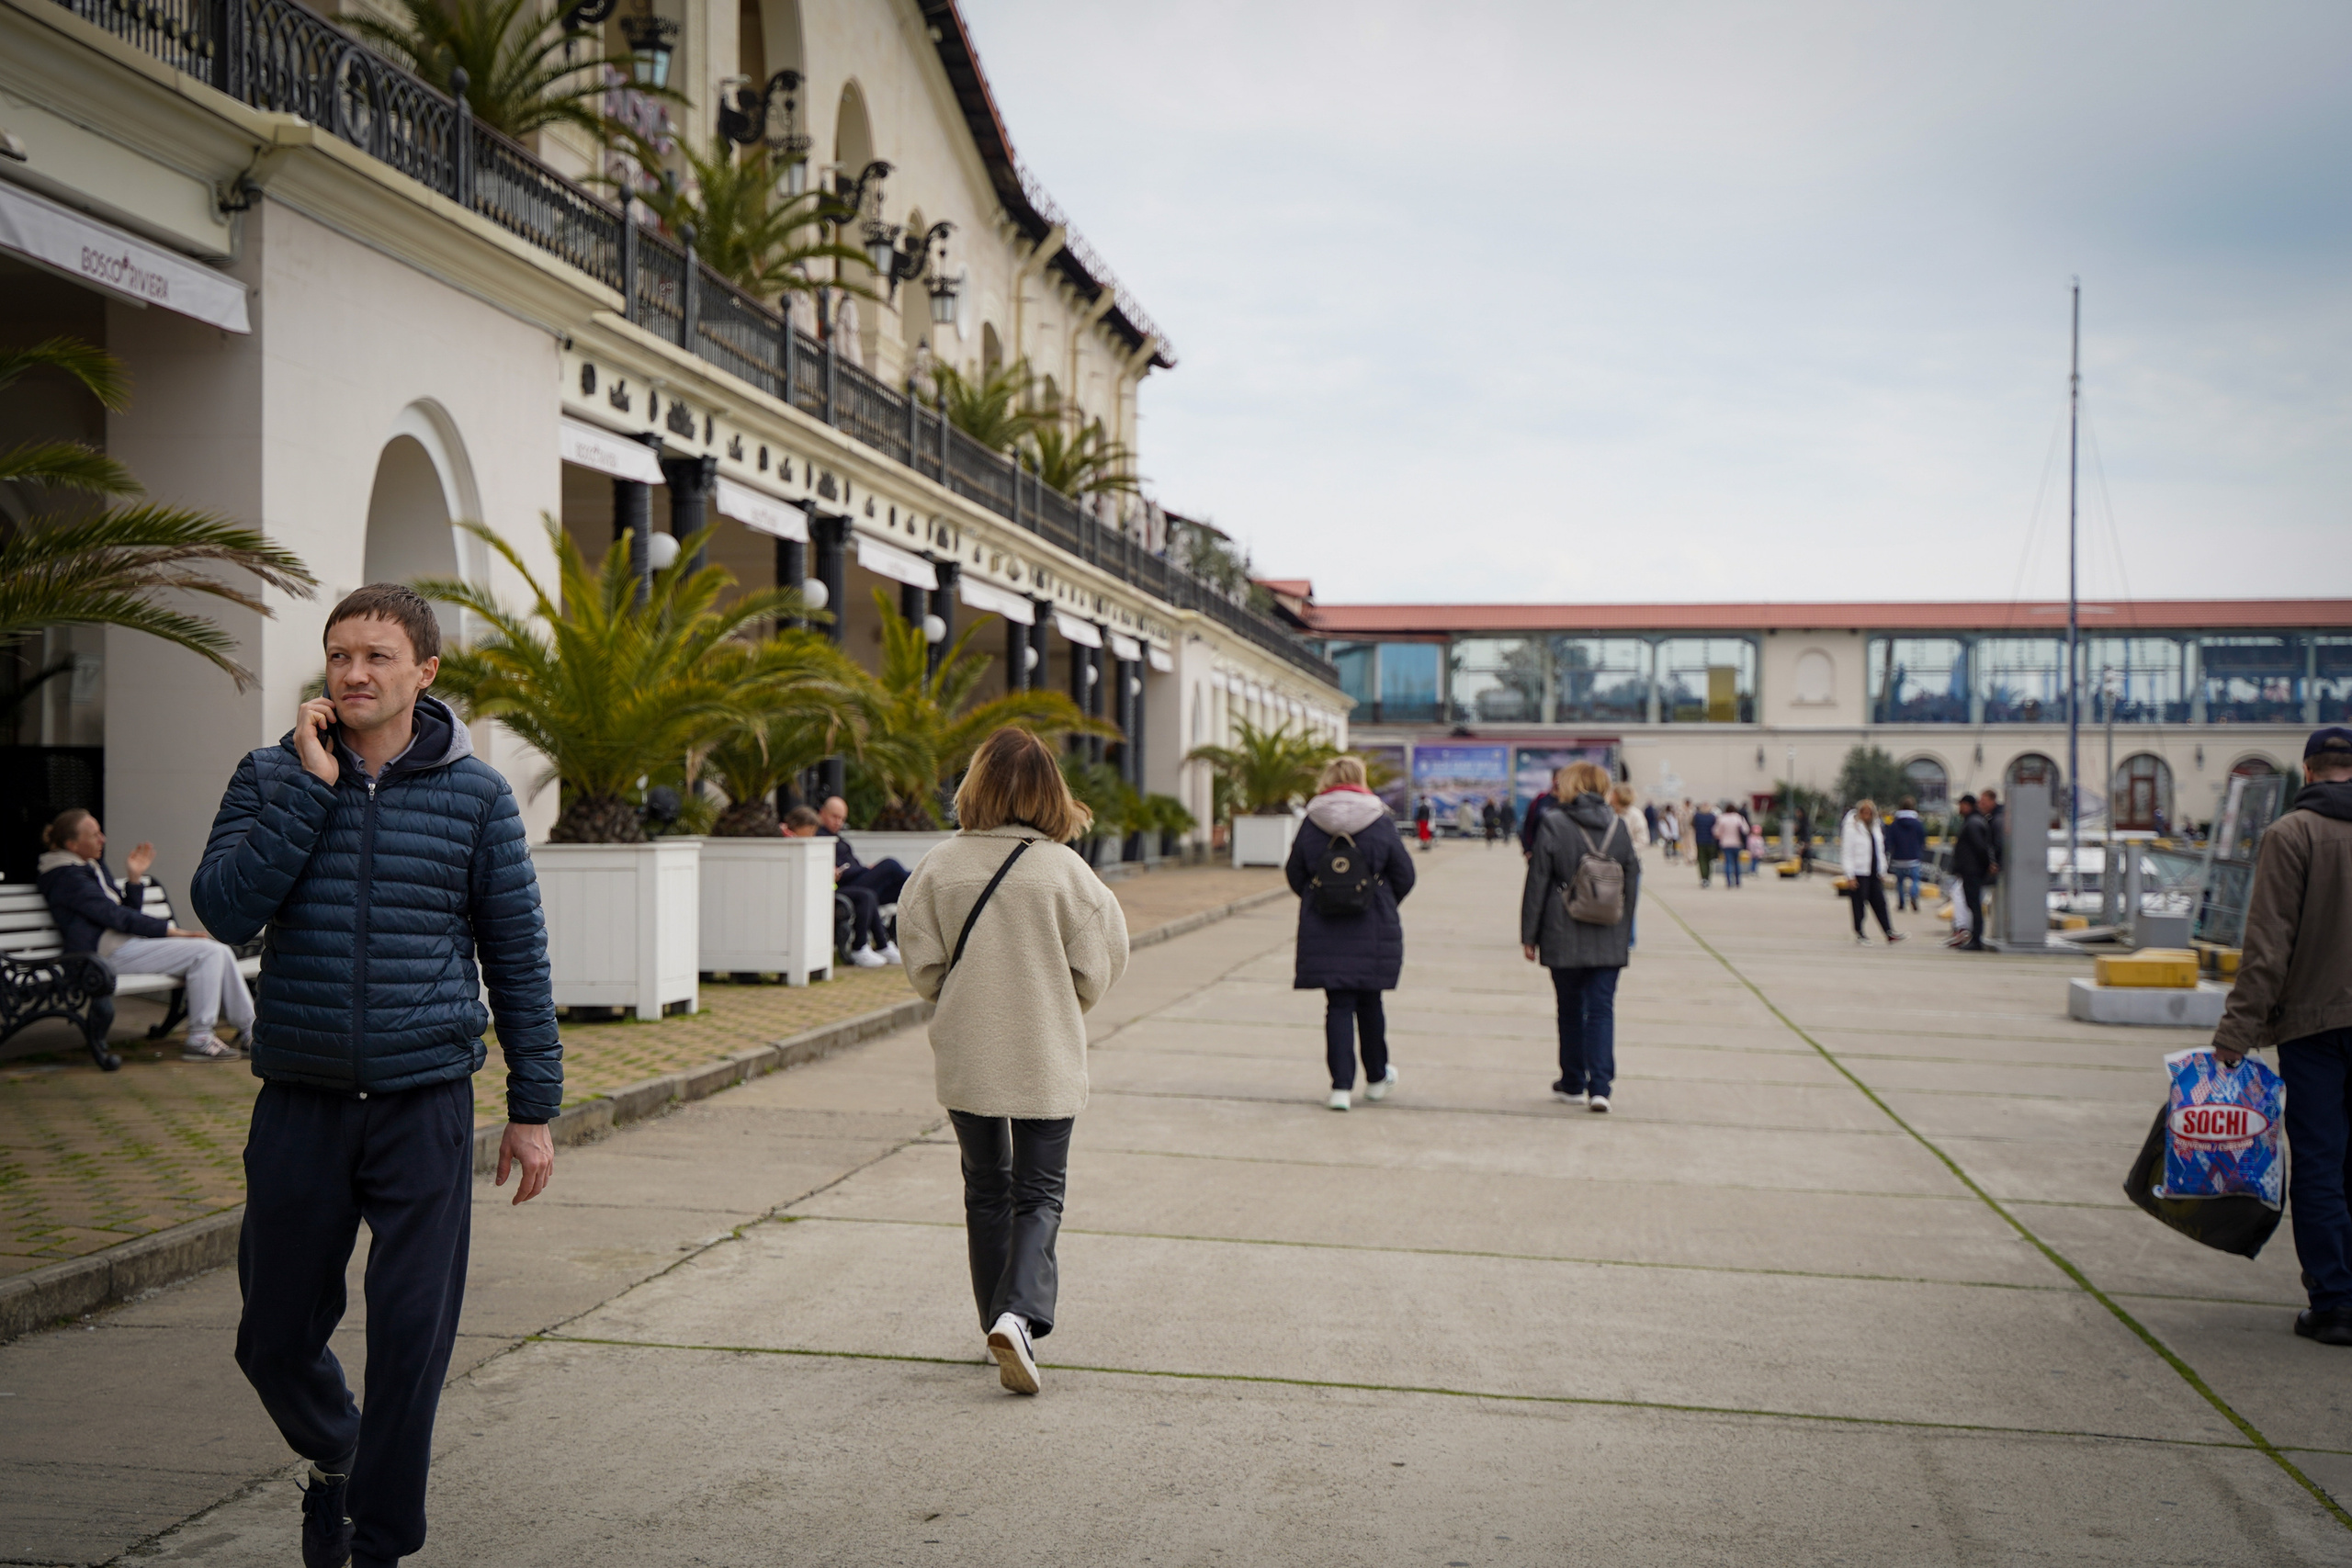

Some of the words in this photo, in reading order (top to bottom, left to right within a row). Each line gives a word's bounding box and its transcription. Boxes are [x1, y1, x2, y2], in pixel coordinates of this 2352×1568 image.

[81, 245, 123, 284] BOSCO
[130, 265, 170, 300] RIVIERA
[2183, 1110, 2248, 1135] SOCHI
[2175, 1138, 2212, 1152] SOUVENIR
